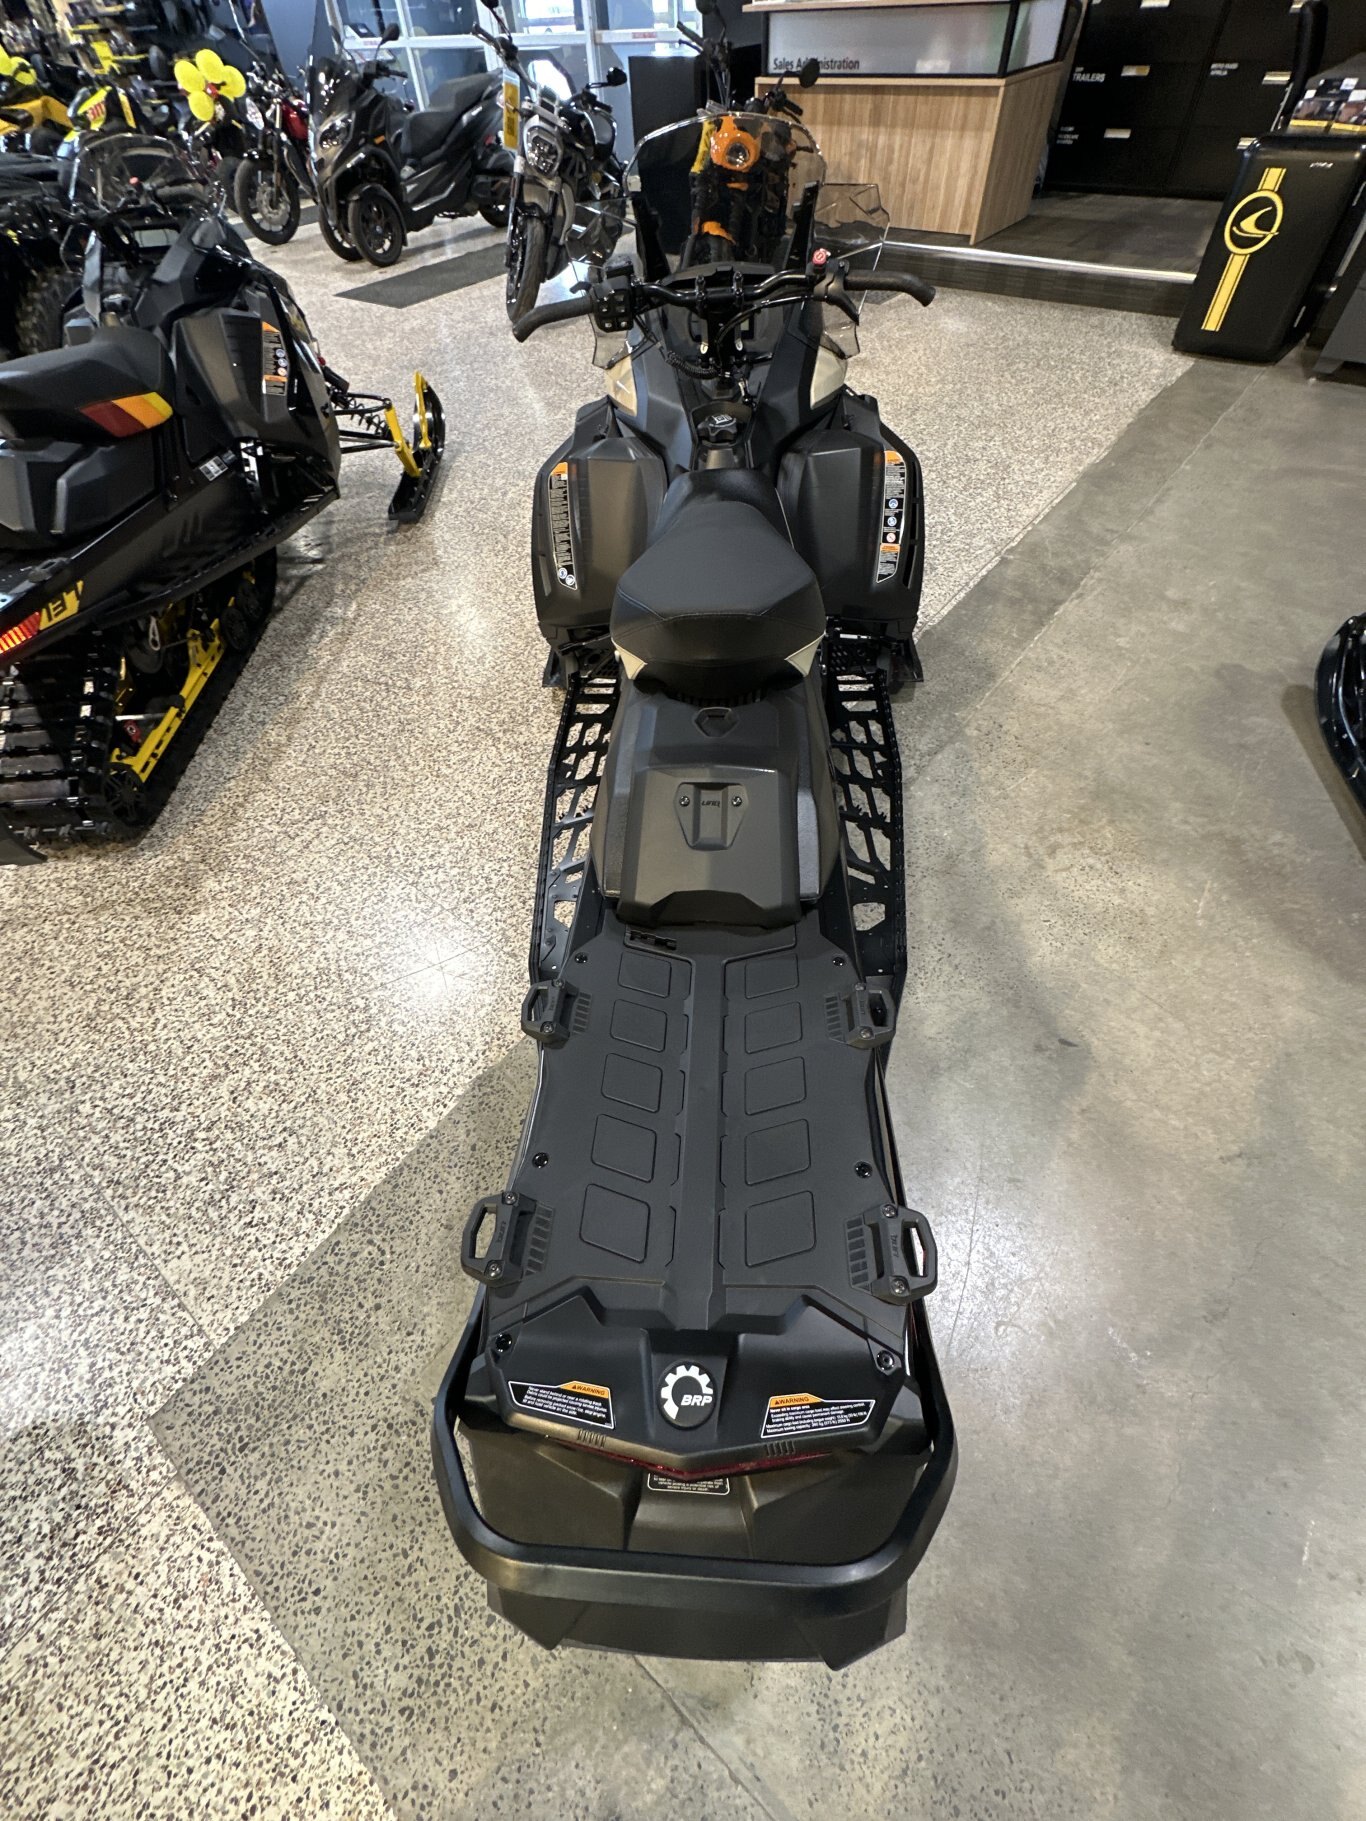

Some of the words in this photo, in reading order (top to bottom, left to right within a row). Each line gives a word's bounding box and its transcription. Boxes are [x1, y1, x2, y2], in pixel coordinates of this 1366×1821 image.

[773, 57, 794, 70] Sales
[796, 57, 860, 70] Adnistration
[1072, 74, 1106, 82] TRAILERS
[577, 1385, 604, 1395] WARNING
[681, 1395, 712, 1406] BRP
[779, 1397, 809, 1405] WARNING
